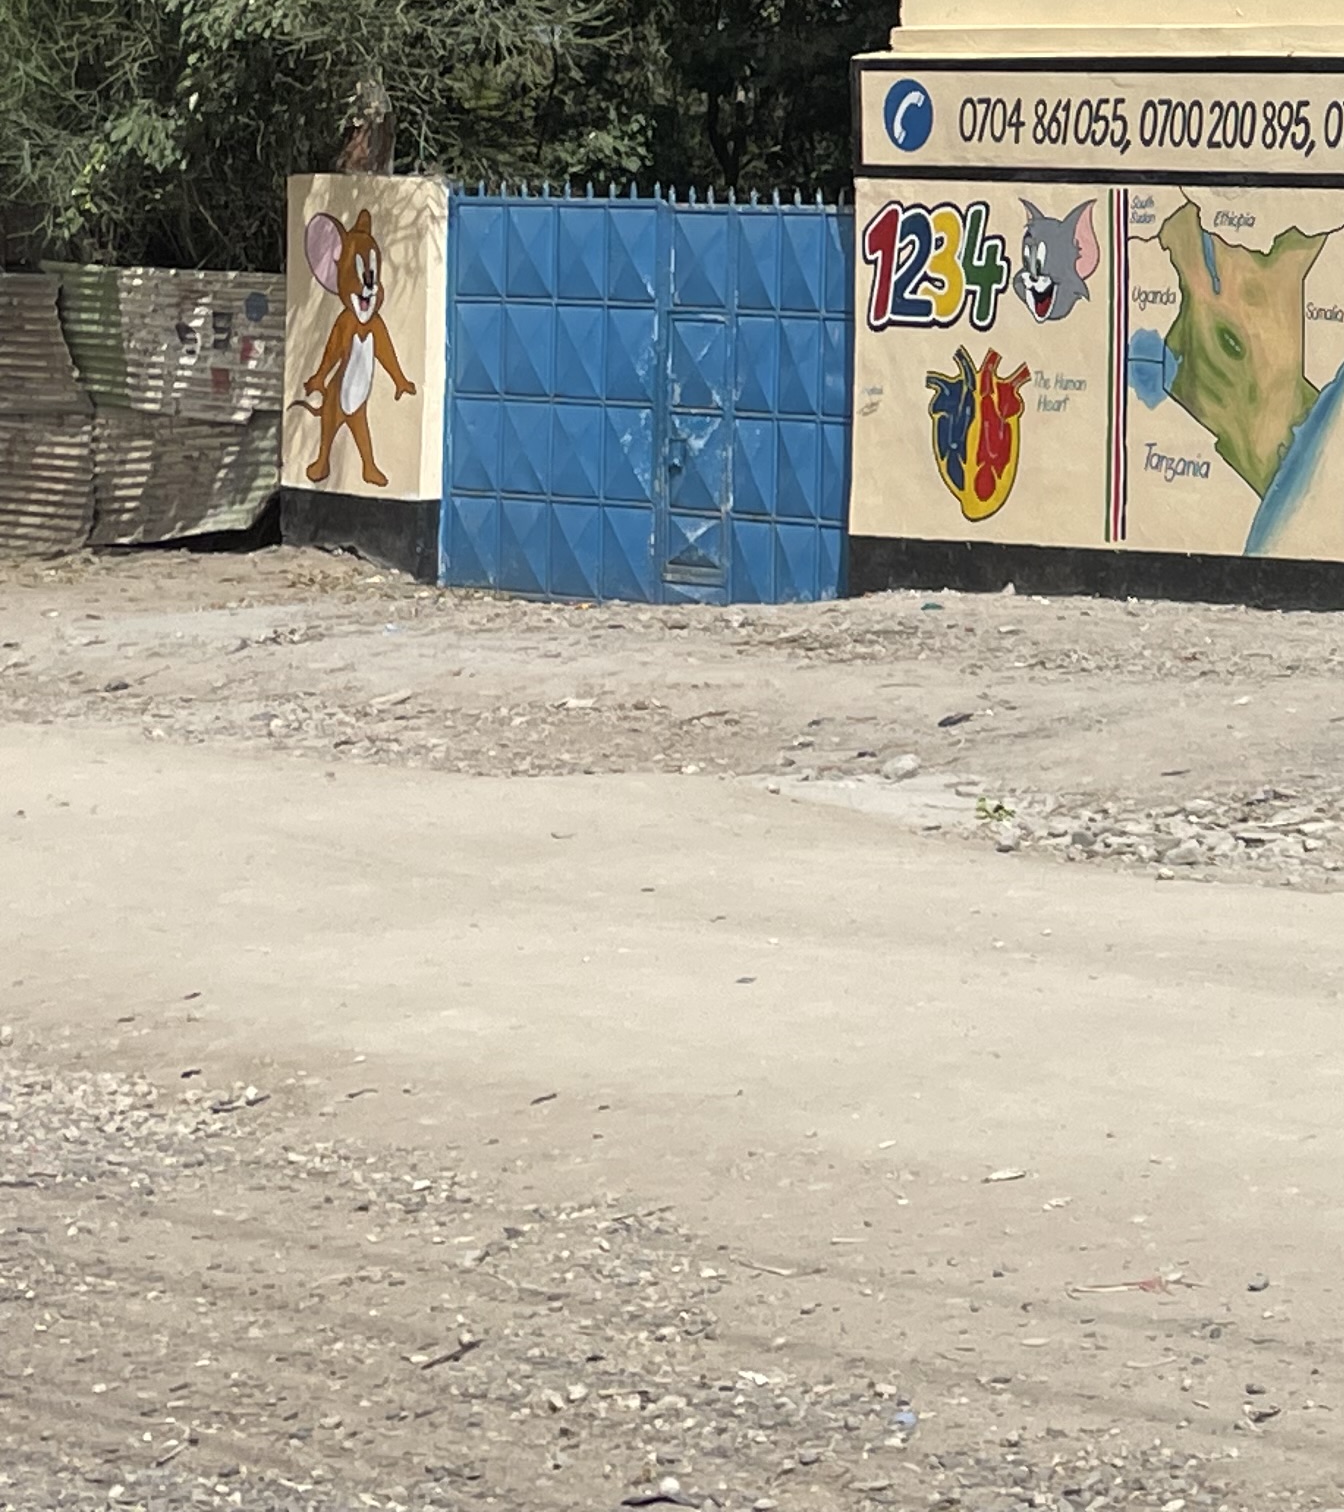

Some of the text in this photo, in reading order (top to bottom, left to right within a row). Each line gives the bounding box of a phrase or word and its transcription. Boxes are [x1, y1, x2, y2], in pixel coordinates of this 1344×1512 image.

[959, 97, 1025, 144] 0704
[1140, 98, 1201, 148] 0700
[1208, 99, 1253, 149] 200
[1261, 99, 1316, 157] 895,
[1213, 210, 1256, 232] Ethiopia
[862, 199, 1011, 332] 1234
[1131, 286, 1177, 310] Uganda
[1034, 370, 1087, 391] The Human
[1037, 393, 1070, 413] Heart
[1144, 442, 1211, 482] Tanzania
